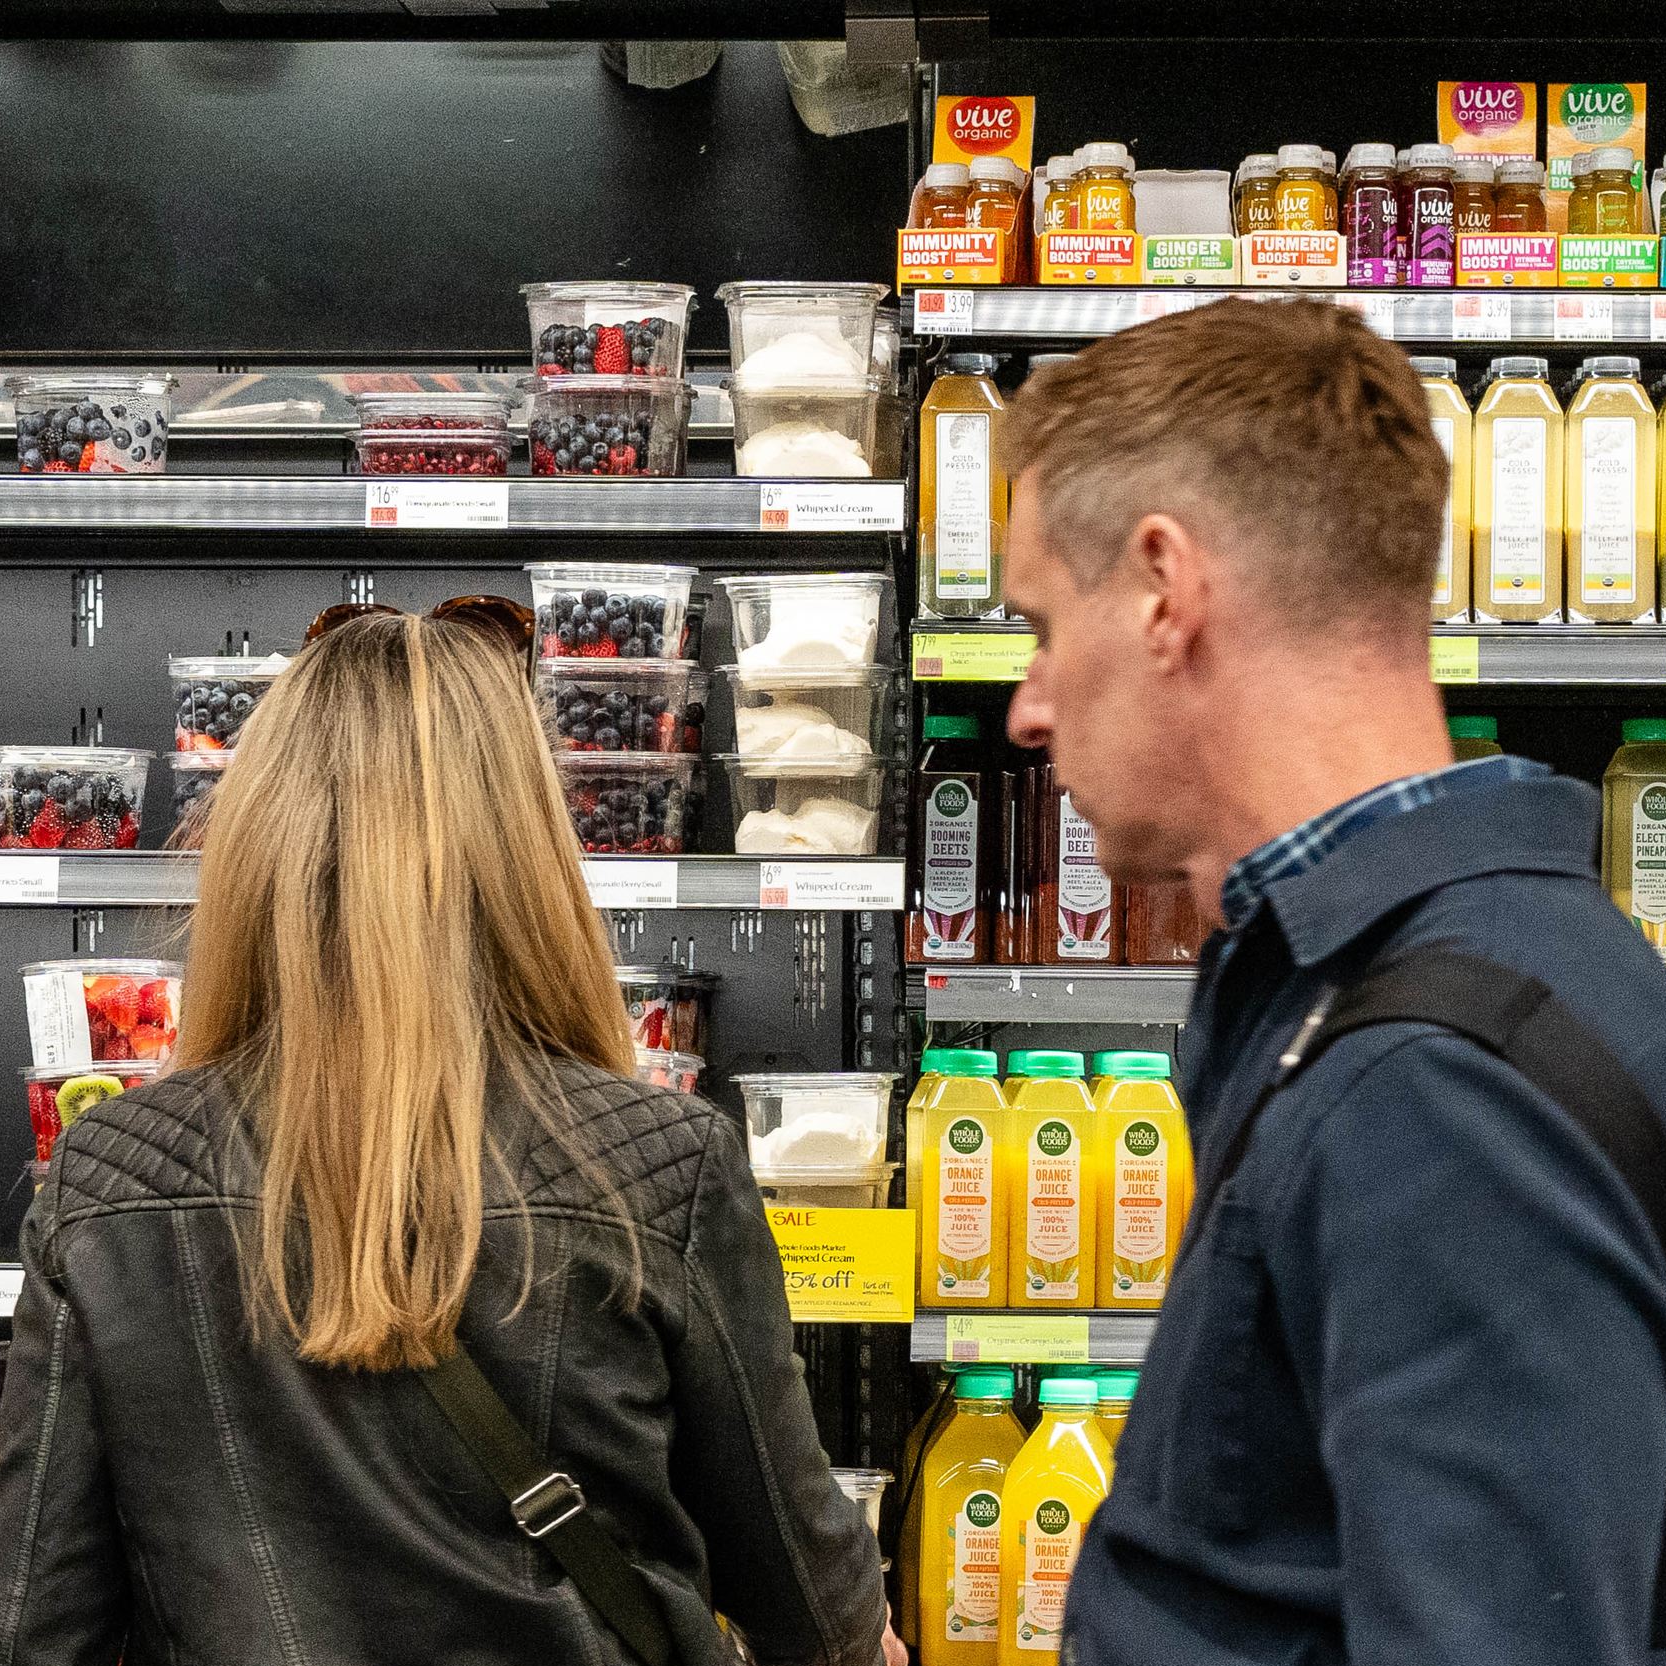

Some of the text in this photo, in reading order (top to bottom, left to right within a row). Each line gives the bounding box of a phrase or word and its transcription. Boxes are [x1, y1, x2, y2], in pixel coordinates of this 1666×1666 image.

[1458, 85, 1516, 108] vive
[1568, 89, 1626, 113] vive
[955, 106, 1012, 127] vive
[1458, 110, 1516, 122] organic
[1568, 114, 1625, 126] organic
[954, 128, 1011, 140] organic
[903, 234, 996, 250] IMMUNITY
[1050, 236, 1133, 250] IMMUNITY
[1253, 236, 1335, 251] TURMERIC
[1462, 238, 1554, 256] IMMUNITY
[1156, 241, 1221, 256] GINGER
[1563, 240, 1655, 257] IMMUNITY
[903, 251, 949, 265] BOOST
[1049, 251, 1090, 264] BOOST
[1153, 256, 1193, 268] BOOST
[1258, 252, 1299, 264] BOOST
[1462, 256, 1507, 269] BOOST
[1563, 258, 1608, 271] BOOST
[932, 831, 971, 841] BOOMING
[933, 844, 968, 855] BEETS
[795, 882, 872, 893] Whipped Cream
[953, 1129, 981, 1137] WHOLE
[954, 1136, 980, 1145] FOODS
[947, 1167, 984, 1180] ORANGE
[1036, 1169, 1072, 1181] ORANGE
[951, 1182, 980, 1193] JUICE
[1039, 1183, 1068, 1195] JUICE
[773, 1212, 817, 1226] SALE
[954, 1214, 976, 1222] 100%
[951, 1223, 979, 1231] JUICE
[822, 1254, 855, 1262] Cream
[823, 1270, 855, 1288] off
